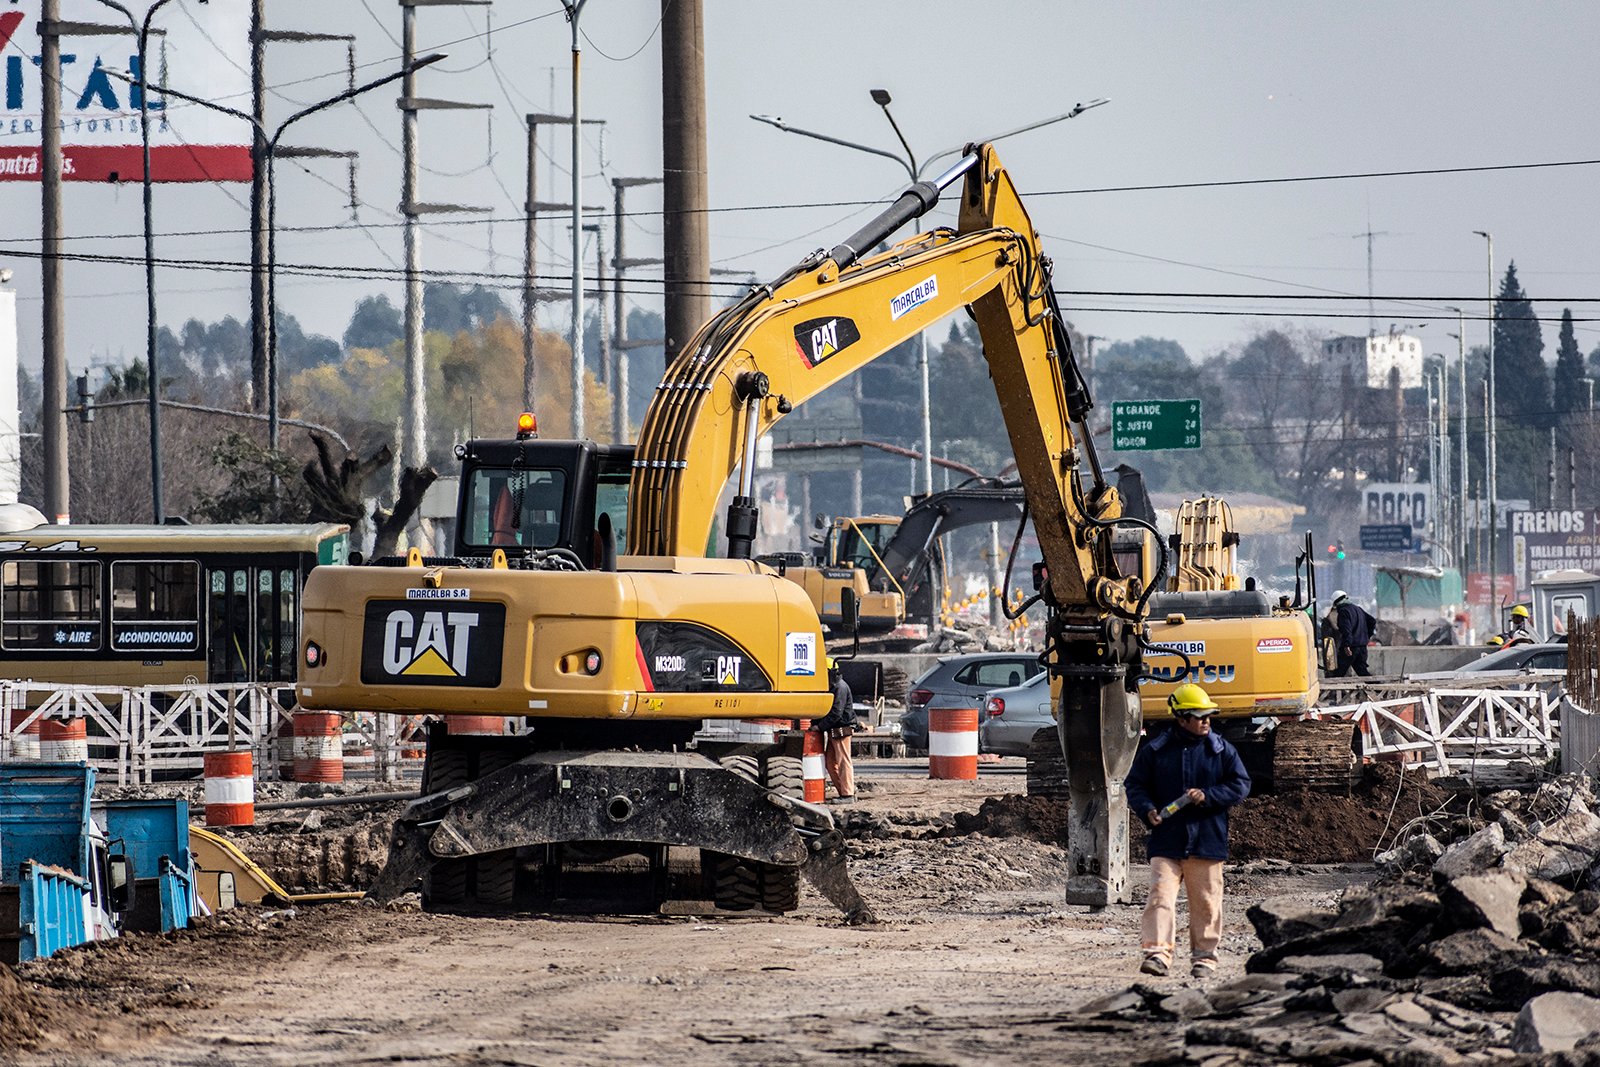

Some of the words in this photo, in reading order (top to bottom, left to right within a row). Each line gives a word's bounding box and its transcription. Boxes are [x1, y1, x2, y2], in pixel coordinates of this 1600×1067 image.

[893, 279, 936, 314] MARCALBA
[811, 319, 838, 361] CAT
[1512, 511, 1585, 533] FRENOS
[408, 589, 451, 598] MARCALBA
[453, 589, 468, 598] S.A.
[68, 631, 91, 643] AIRE
[118, 631, 193, 643] ACONDICIONADO
[383, 610, 479, 676] CAT
[655, 655, 686, 672] M320D2
[717, 655, 741, 684] CAT
[714, 699, 723, 708] RE
